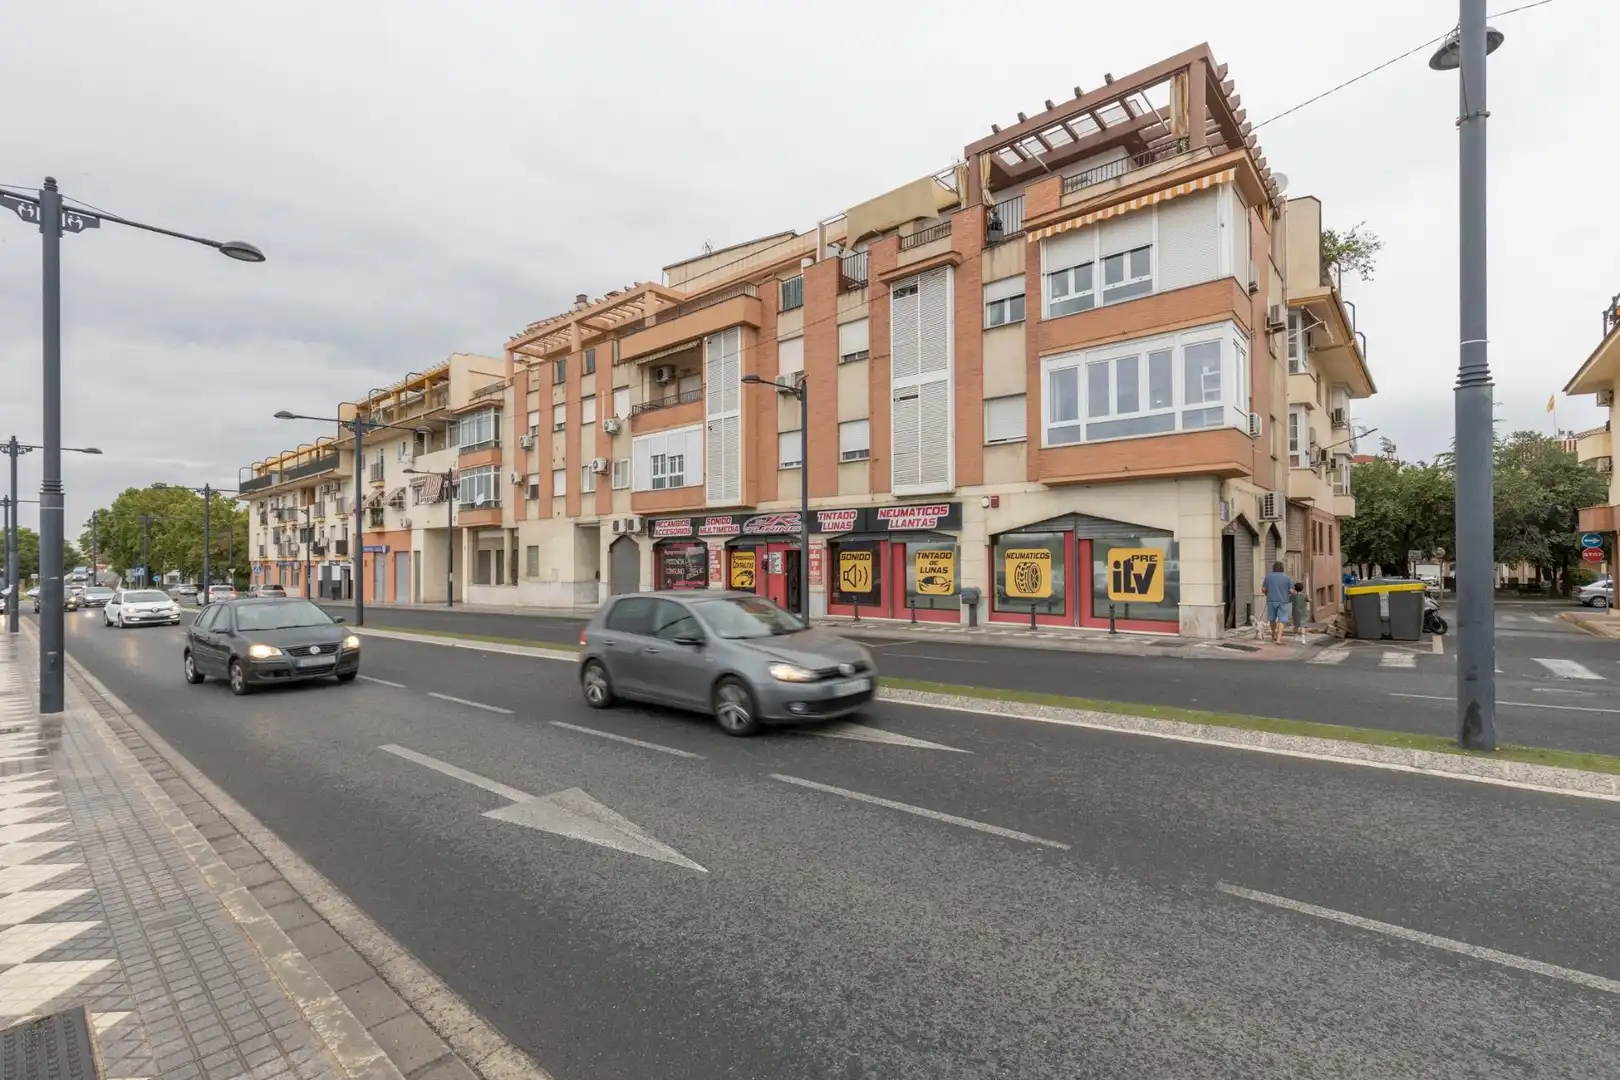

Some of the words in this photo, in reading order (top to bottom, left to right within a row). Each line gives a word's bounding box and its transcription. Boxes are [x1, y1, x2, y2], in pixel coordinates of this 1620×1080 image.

[818, 510, 856, 521] TINTADO
[879, 506, 949, 518] NEUMATICOS
[656, 519, 690, 527] RECAMBIOS
[706, 517, 731, 526] SONIDO
[822, 521, 853, 530] LUNAS
[889, 518, 937, 528] LLANTAS
[655, 527, 691, 536] ACCESORIOS
[698, 525, 739, 534] MULTIMEDIA
[840, 553, 871, 561] SONIDO
[917, 552, 952, 560] TINTADO
[1005, 552, 1050, 560] NEUMATICOS
[1131, 554, 1158, 562] PRE
[919, 566, 948, 574] LUNAS
